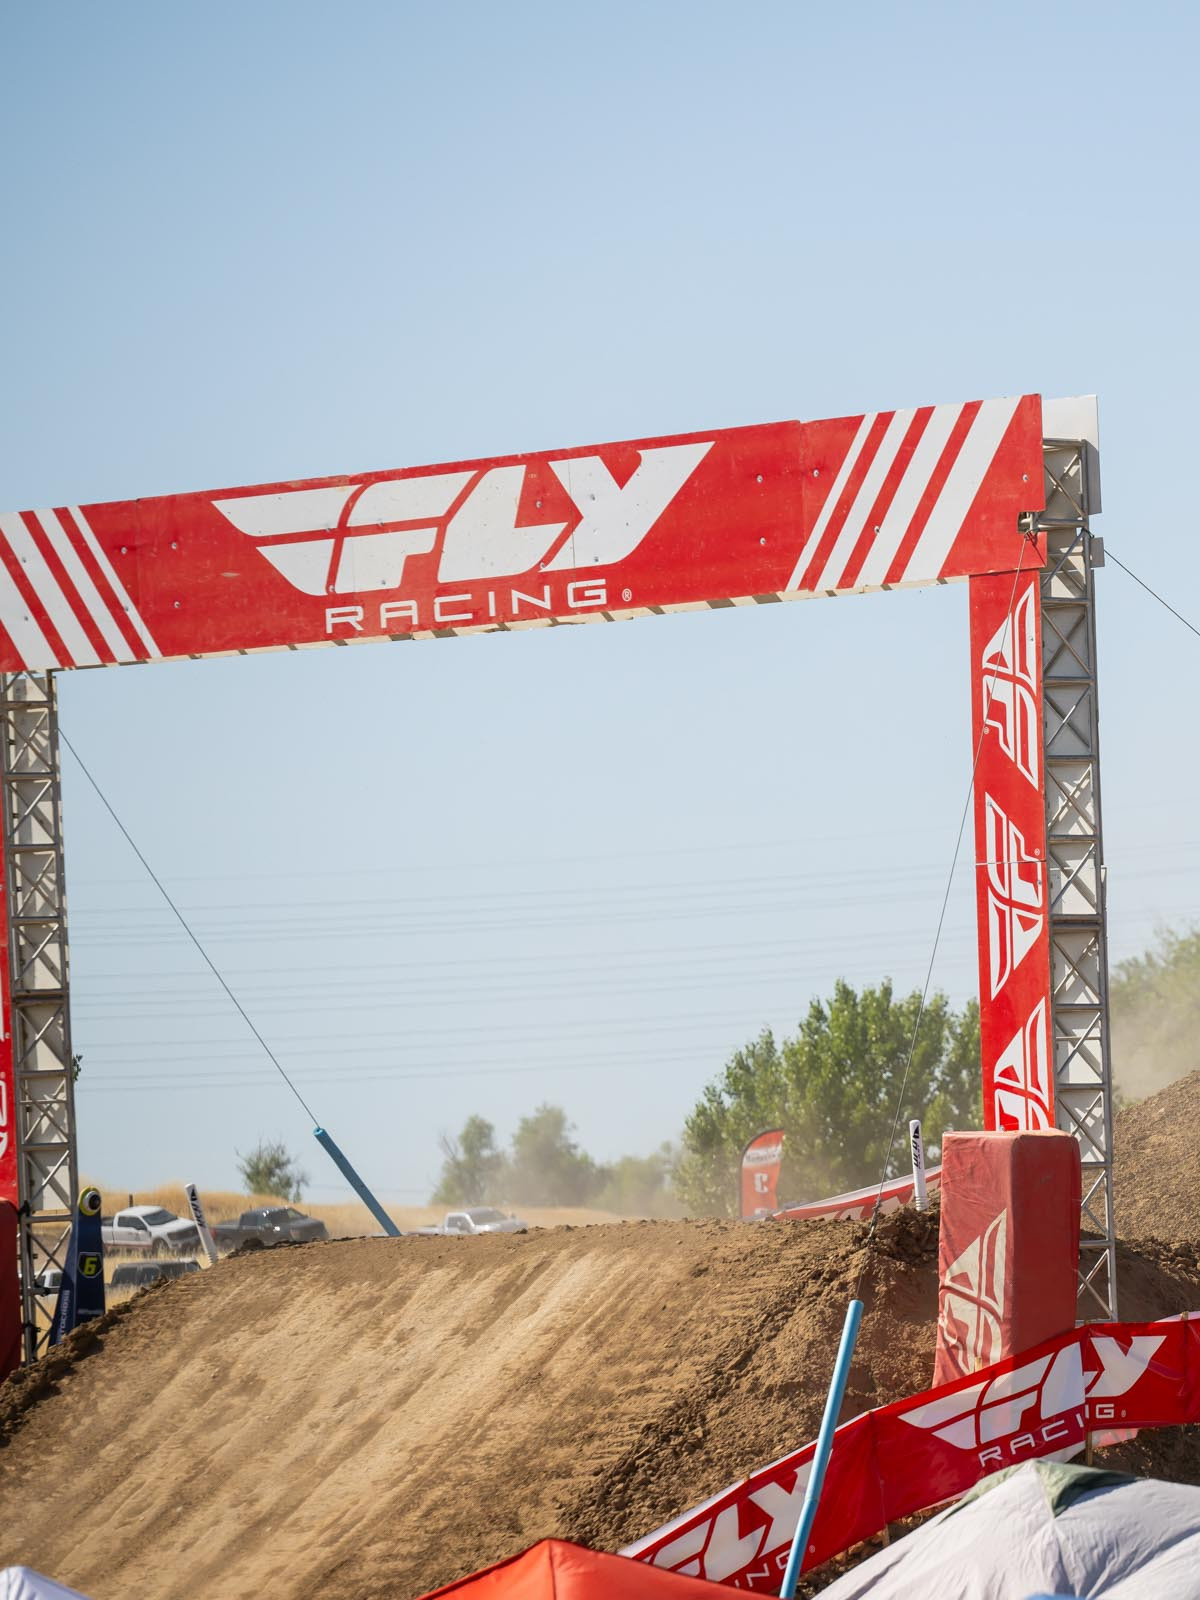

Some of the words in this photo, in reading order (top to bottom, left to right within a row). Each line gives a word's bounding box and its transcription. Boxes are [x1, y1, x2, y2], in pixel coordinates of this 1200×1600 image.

[211, 441, 716, 597] FLY
[325, 579, 608, 634] RACING
[83, 1256, 98, 1276] 6
[898, 1335, 1166, 1450] FLY
